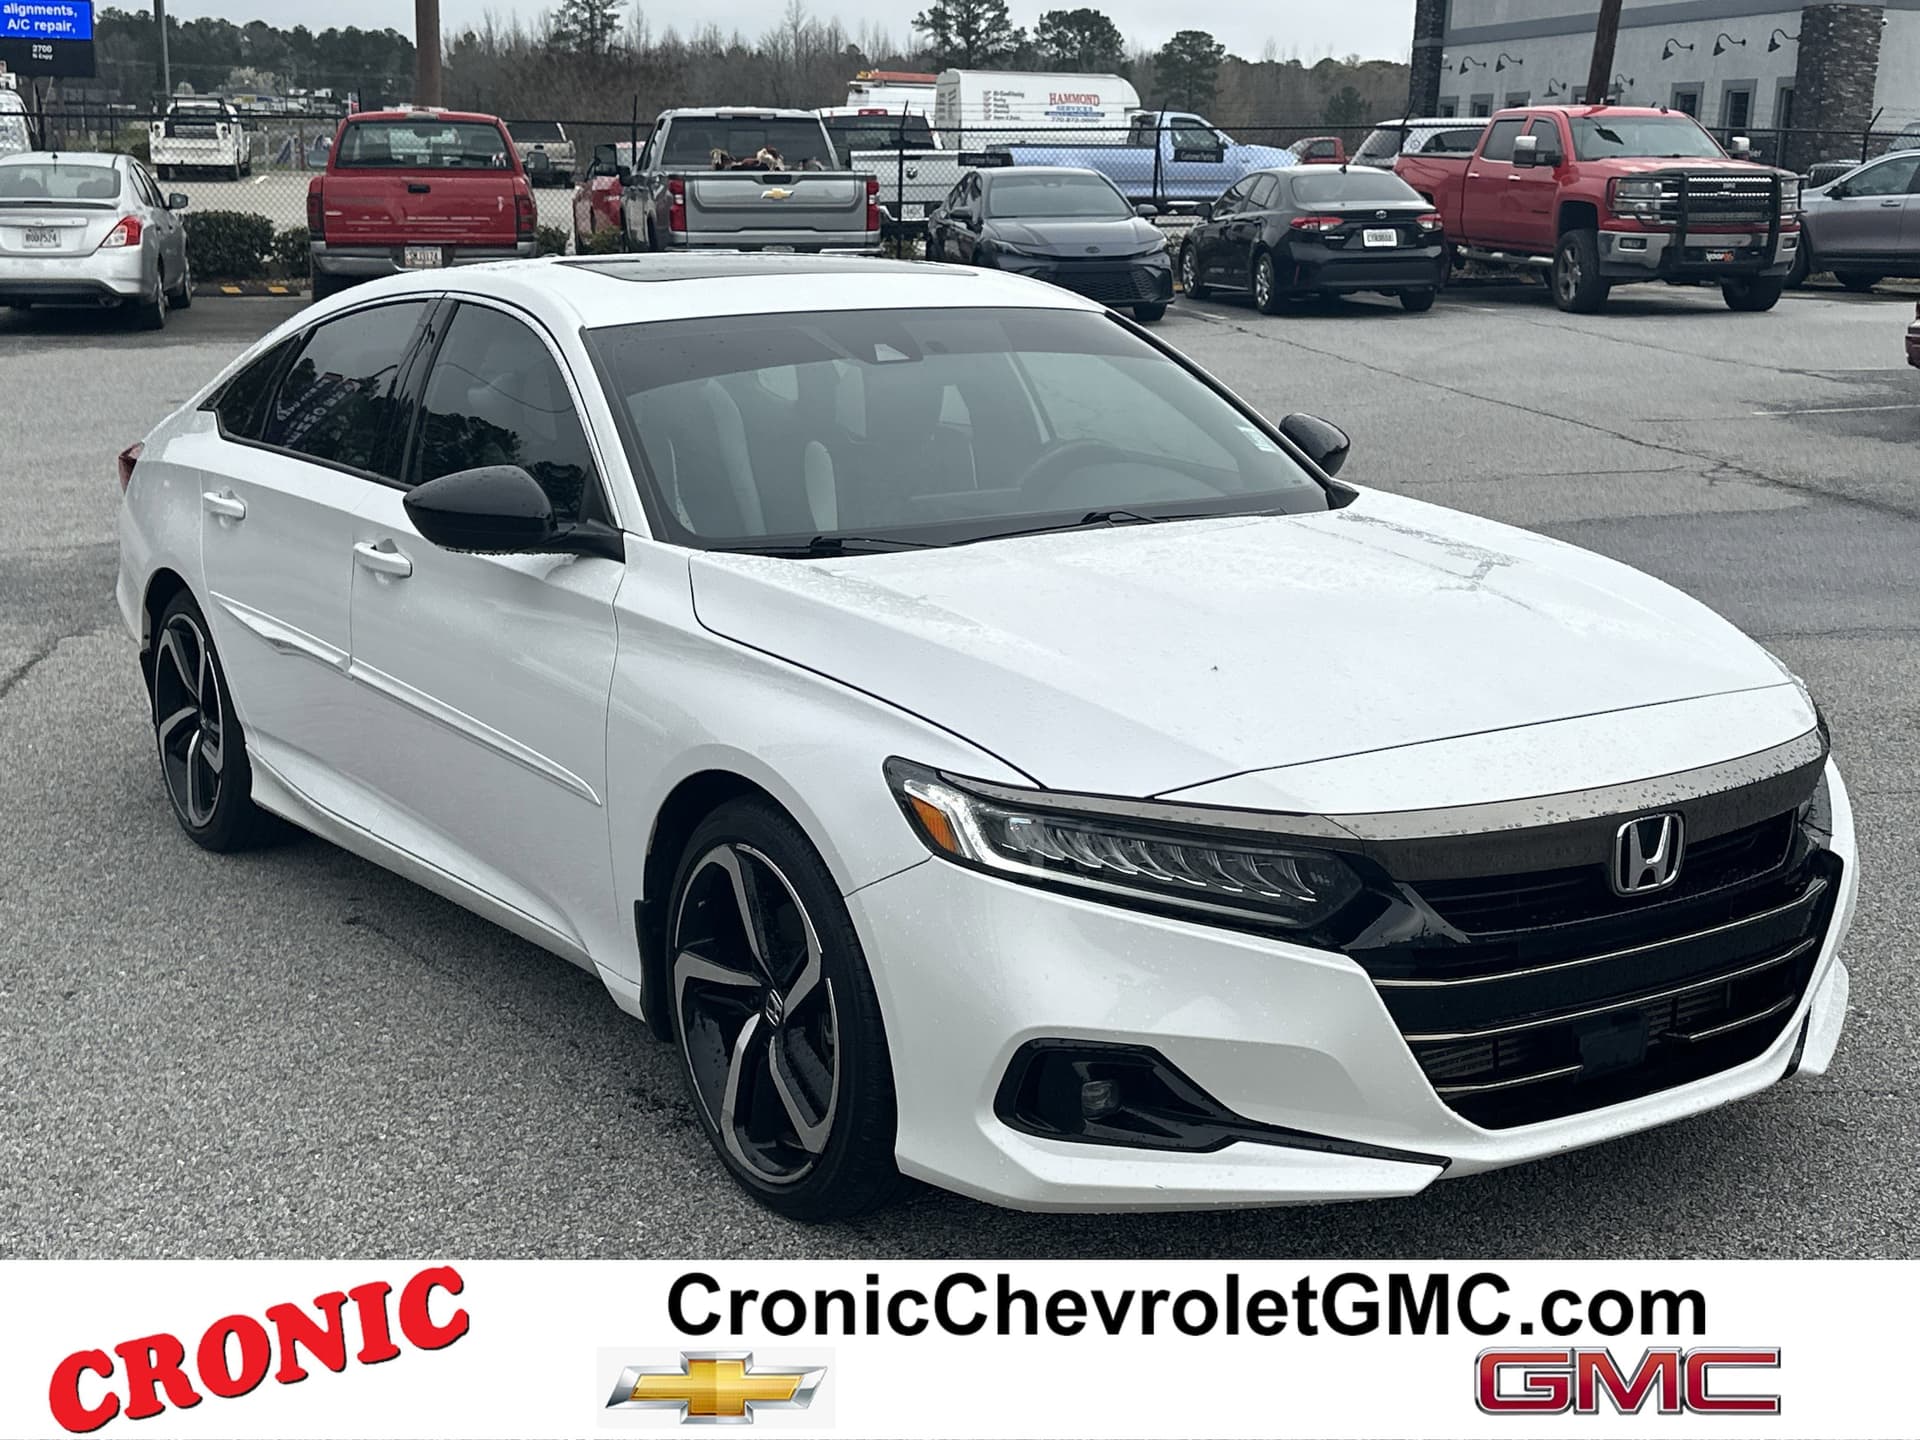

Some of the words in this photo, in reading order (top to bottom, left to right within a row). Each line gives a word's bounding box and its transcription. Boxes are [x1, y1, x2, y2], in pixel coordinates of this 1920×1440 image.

[3, 3, 77, 18] alignments,
[7, 19, 30, 31] A/C
[34, 20, 76, 34] repair,
[32, 44, 52, 53] 2700
[1049, 92, 1100, 107] HAMMOND
